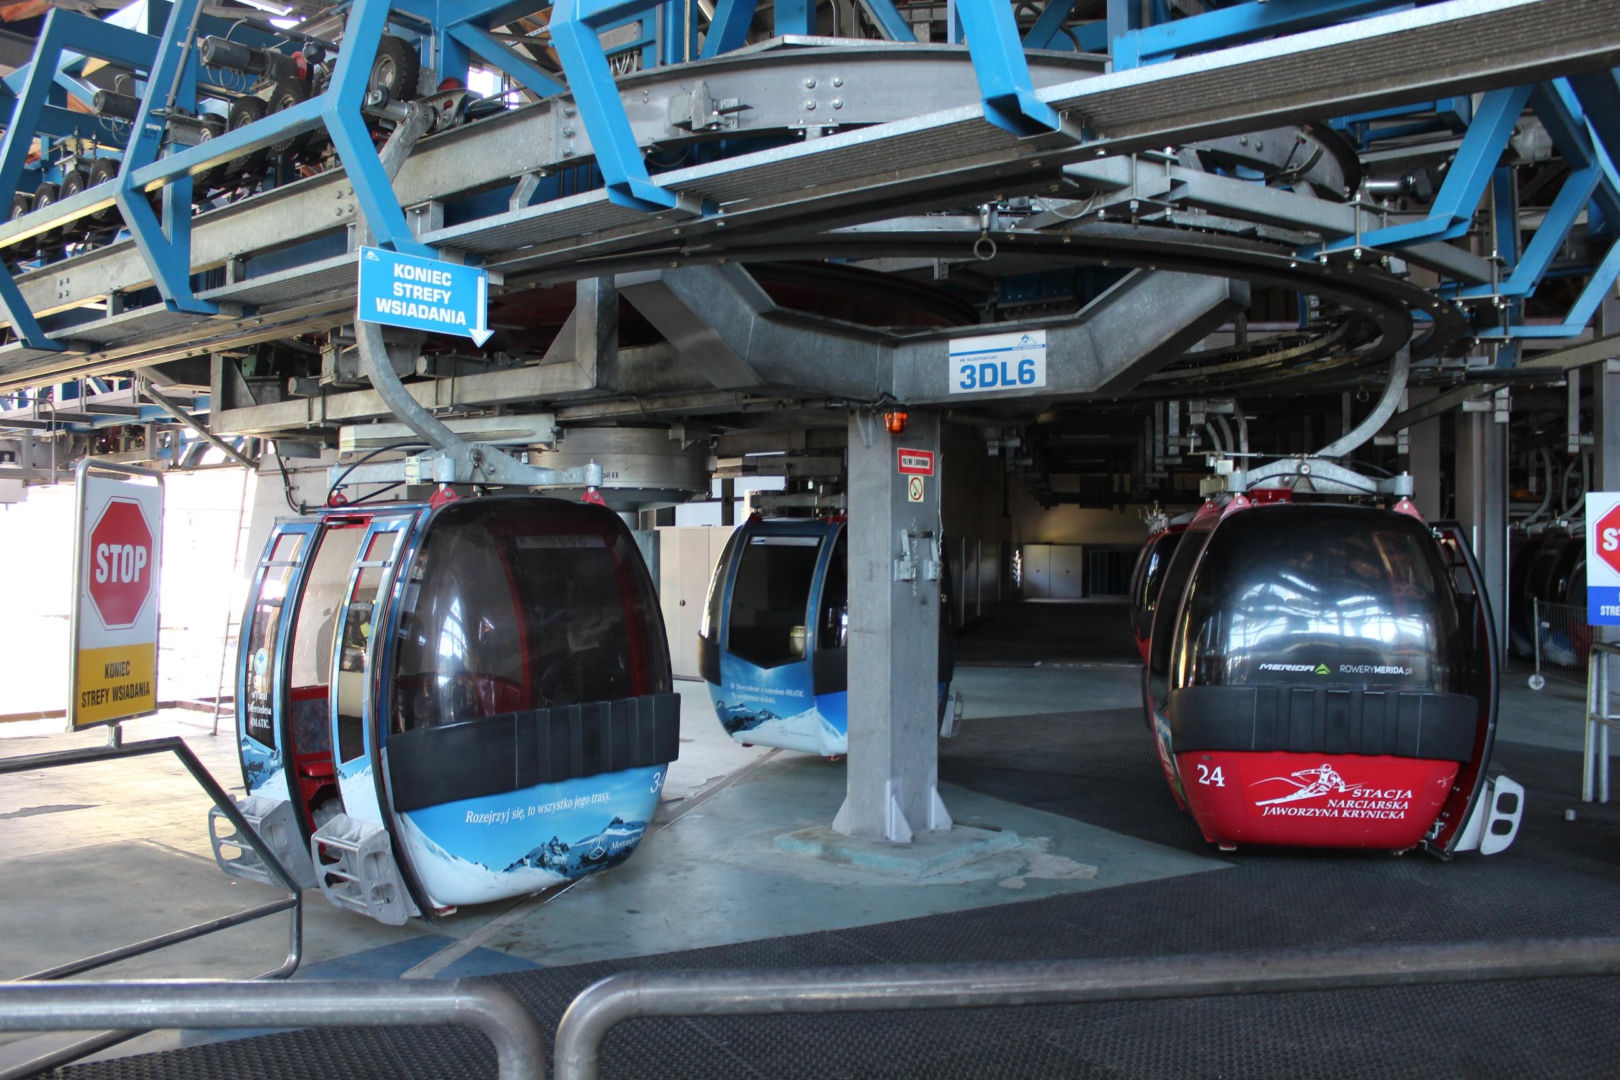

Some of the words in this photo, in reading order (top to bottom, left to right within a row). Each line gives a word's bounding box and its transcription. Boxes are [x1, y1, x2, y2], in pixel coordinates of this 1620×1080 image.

[393, 262, 452, 287] KONIEC
[392, 281, 452, 305] STREFY
[375, 297, 467, 326] WSIADANIA
[959, 358, 1036, 390] 3DL6
[1602, 527, 1620, 552] S
[95, 543, 147, 584] STOP
[104, 660, 131, 679] KONIEC
[1258, 663, 1315, 672] MERIDA
[1339, 664, 1413, 676] ROWERYMERIDA.pl
[81, 687, 110, 708] STREFY
[112, 681, 151, 702] WSIADANIA
[1197, 764, 1225, 787] 24
[1327, 799, 1409, 810] NARCIARSKA
[1351, 788, 1413, 800] STACJA
[465, 808, 510, 825] Rozejrzyj
[511, 808, 525, 821] się,
[527, 806, 536, 816] to
[537, 797, 573, 815] wszystko
[573, 794, 590, 810] jego
[591, 791, 611, 806] trasy.
[1262, 806, 1339, 818] JAWORZYNA
[1341, 809, 1405, 820] KRYNICKA
